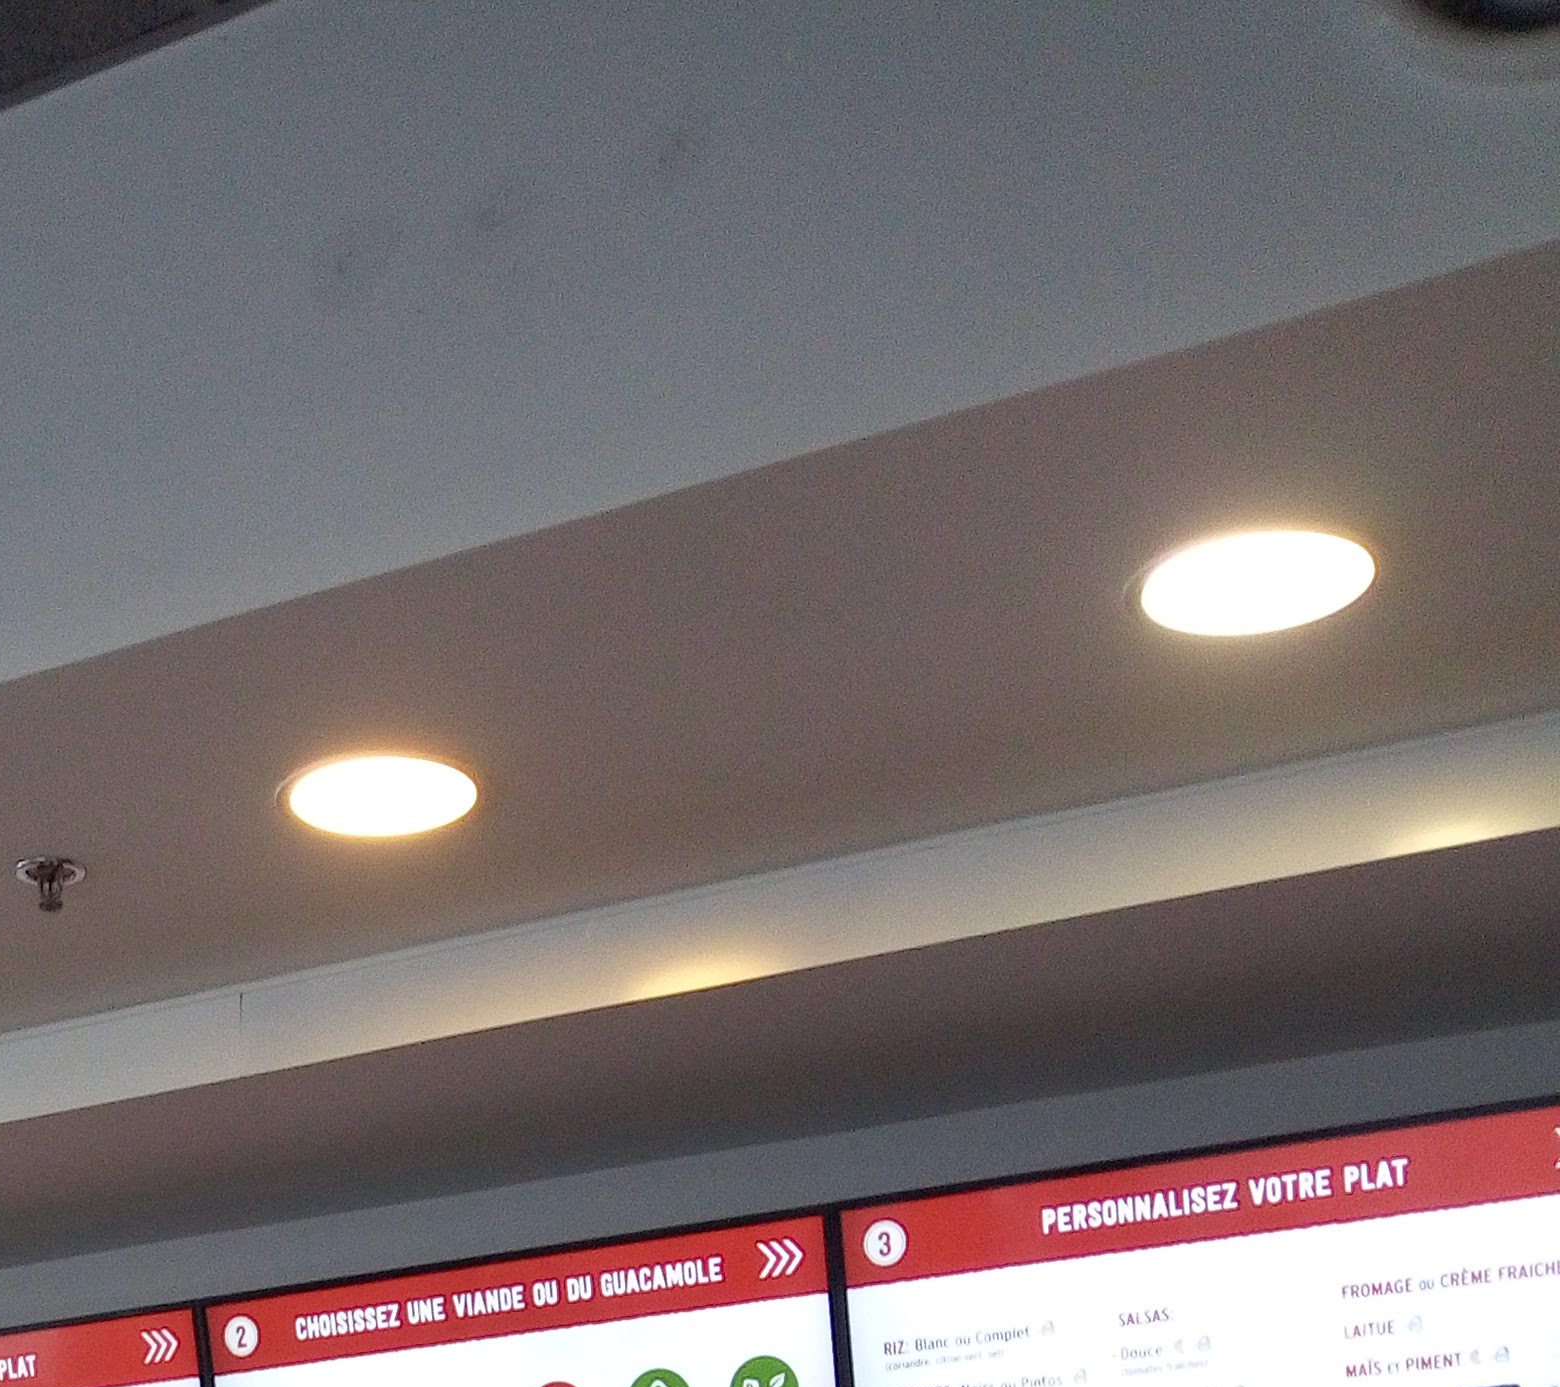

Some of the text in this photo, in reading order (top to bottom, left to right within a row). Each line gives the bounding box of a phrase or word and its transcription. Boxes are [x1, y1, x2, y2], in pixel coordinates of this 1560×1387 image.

[1042, 1158, 1409, 1234] PERSONNALISEZ VOTRE PLAT
[295, 1256, 723, 1340] CHOISISSEZ UNE VIANDE OU DU GUACAMOLE
[1342, 1278, 1413, 1299] FROMAGE
[975, 1326, 1030, 1344] Complet
[1344, 1320, 1395, 1339] LAITUE
[1406, 1353, 1460, 1372] PIMENT
